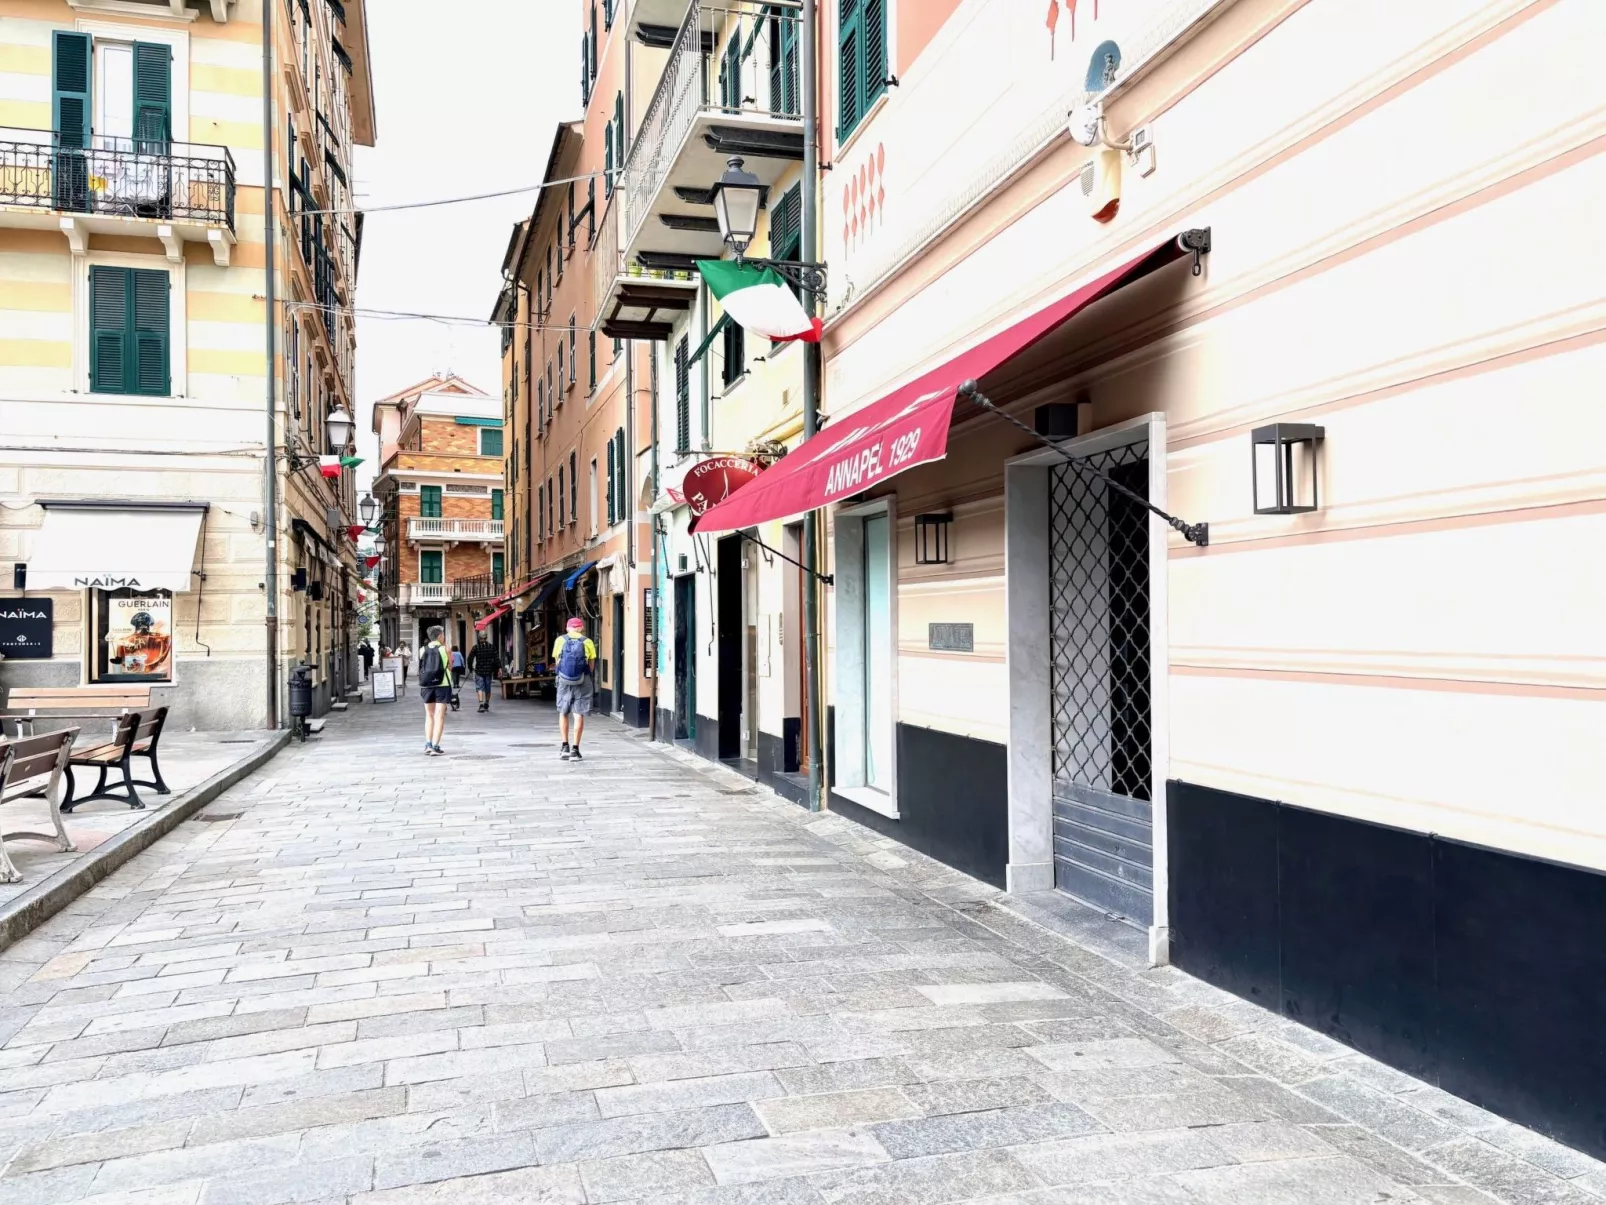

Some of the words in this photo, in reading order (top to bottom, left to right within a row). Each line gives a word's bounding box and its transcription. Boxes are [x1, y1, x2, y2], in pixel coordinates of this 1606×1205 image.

[693, 459, 759, 478] FOCACCERIA
[824, 440, 884, 497] ANNAPEL
[888, 427, 922, 469] 1929
[74, 573, 141, 587] NAÏMA
[118, 600, 170, 608] GUERLAIN
